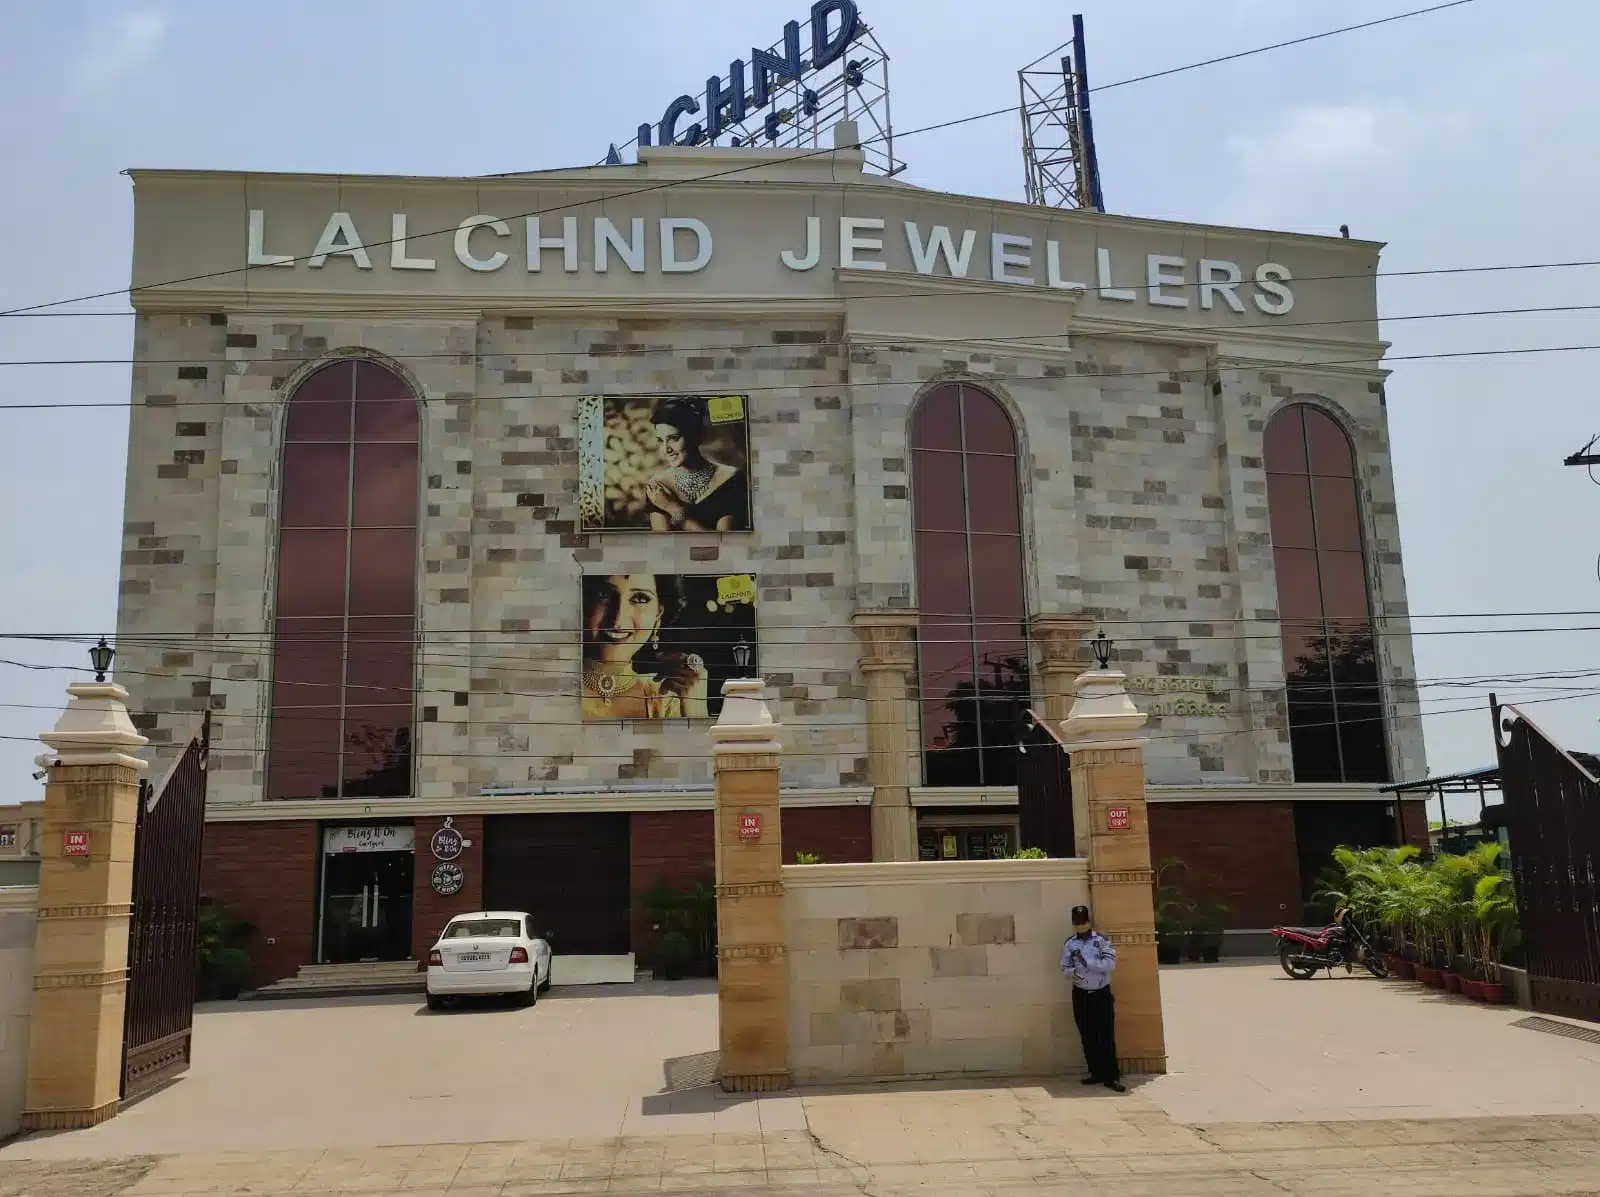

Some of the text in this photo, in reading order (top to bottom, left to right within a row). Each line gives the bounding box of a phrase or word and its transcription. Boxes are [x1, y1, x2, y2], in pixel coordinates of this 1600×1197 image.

[247, 209, 1295, 316] LALCHND JEWELLERS
[1110, 810, 1127, 818] OUT
[744, 818, 755, 827] IN
[70, 835, 83, 844] IN
